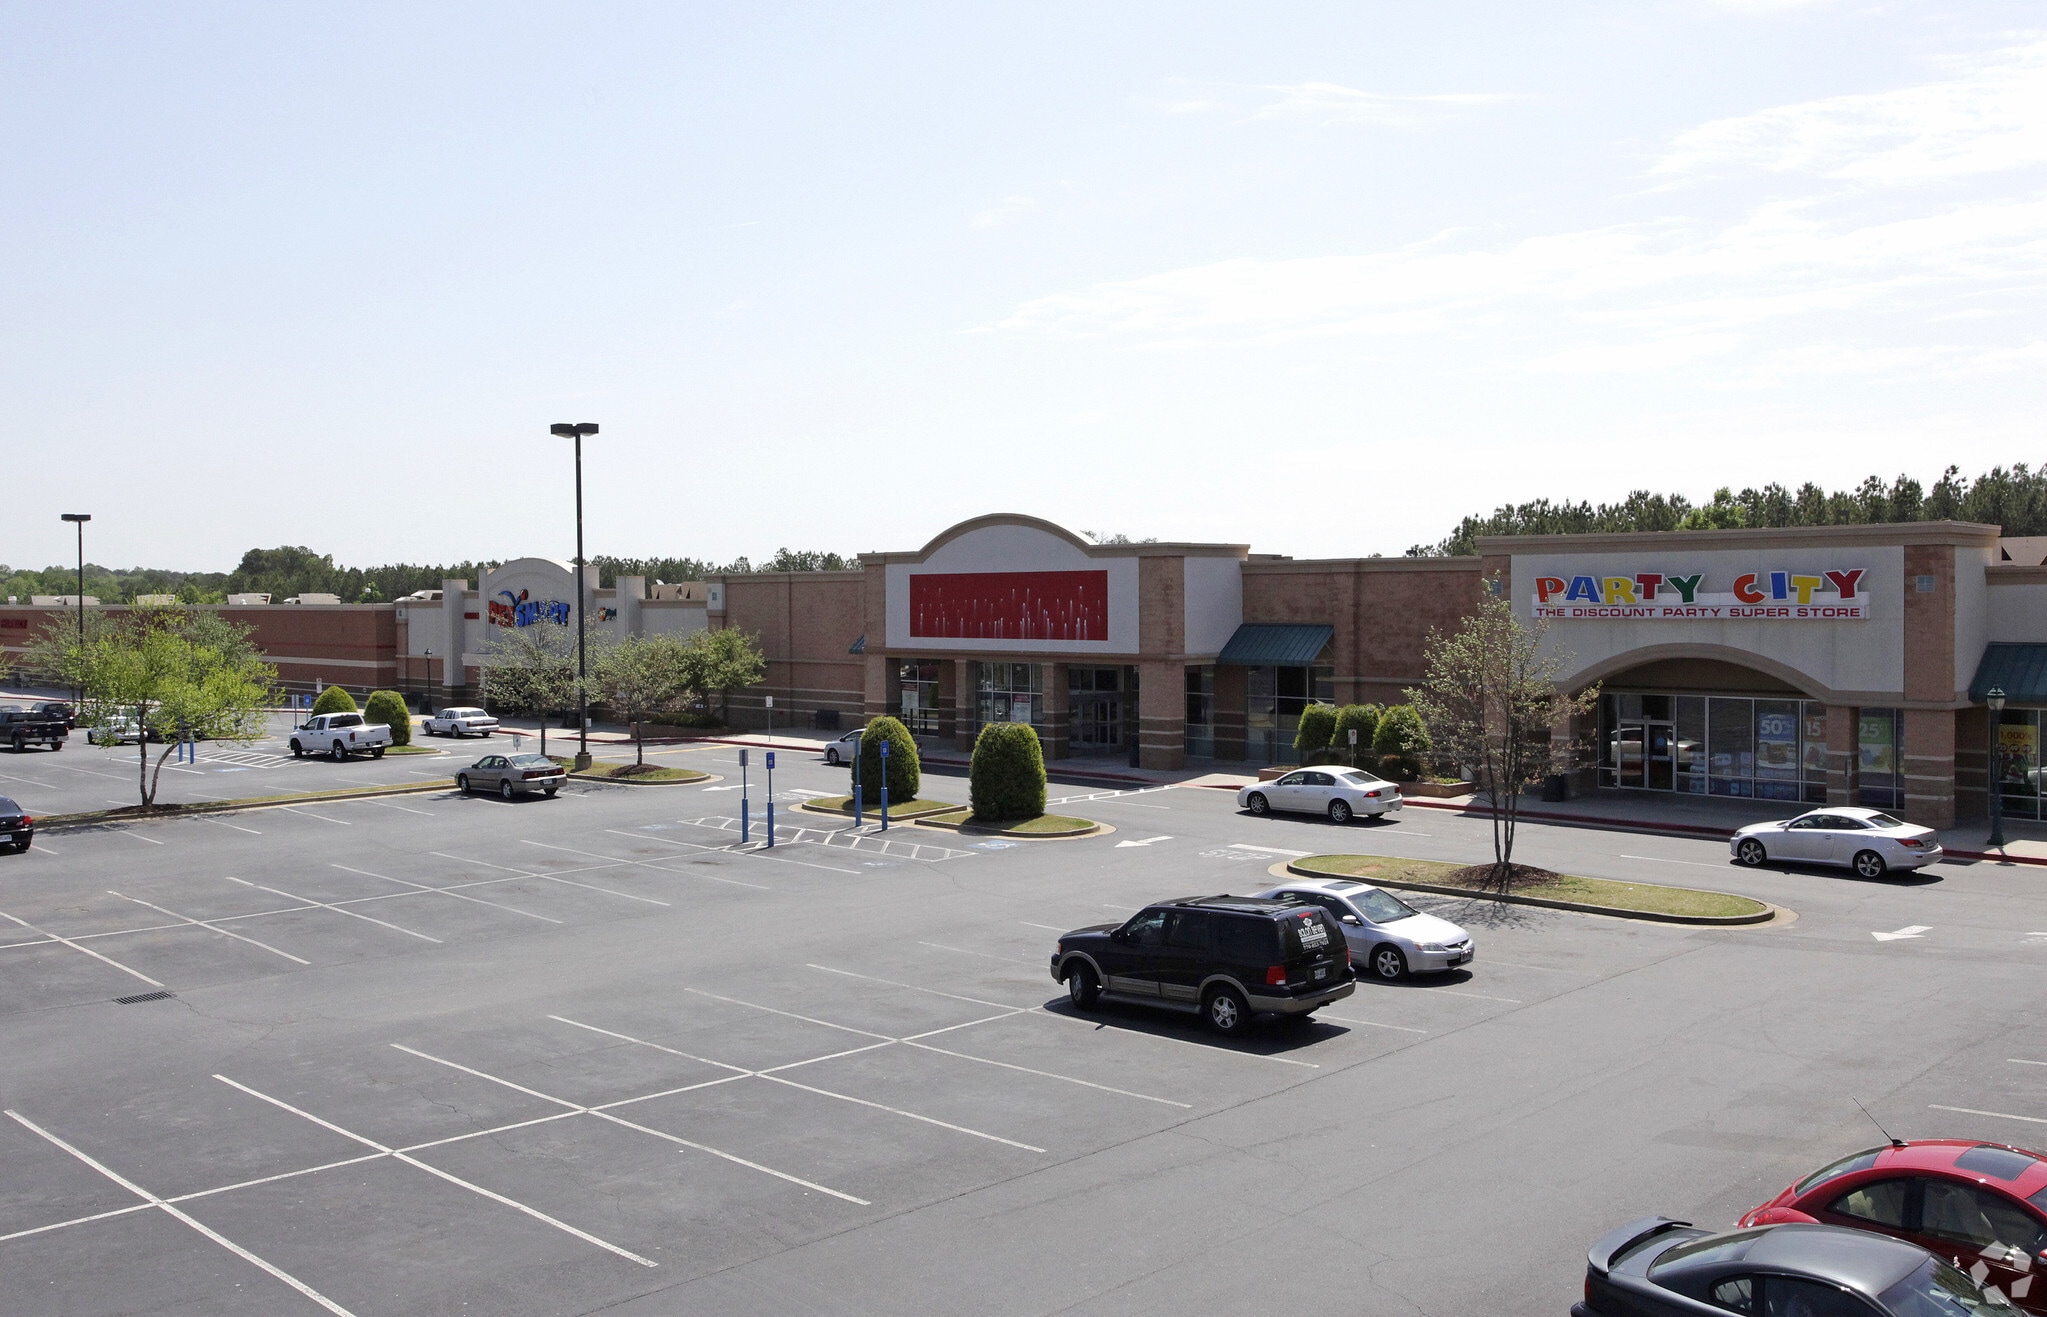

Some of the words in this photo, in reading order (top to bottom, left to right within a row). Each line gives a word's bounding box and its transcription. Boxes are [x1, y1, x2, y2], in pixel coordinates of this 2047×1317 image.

[1535, 573, 1704, 605] PARTY
[1732, 569, 1866, 605] CITY
[1536, 608, 1565, 617] THE
[1572, 608, 1656, 617] DISCOUNT
[1663, 608, 1721, 617] PARTY
[1729, 608, 1789, 617] SUPER
[1797, 608, 1860, 617] STORE
[1198, 849, 1273, 861] STOP
